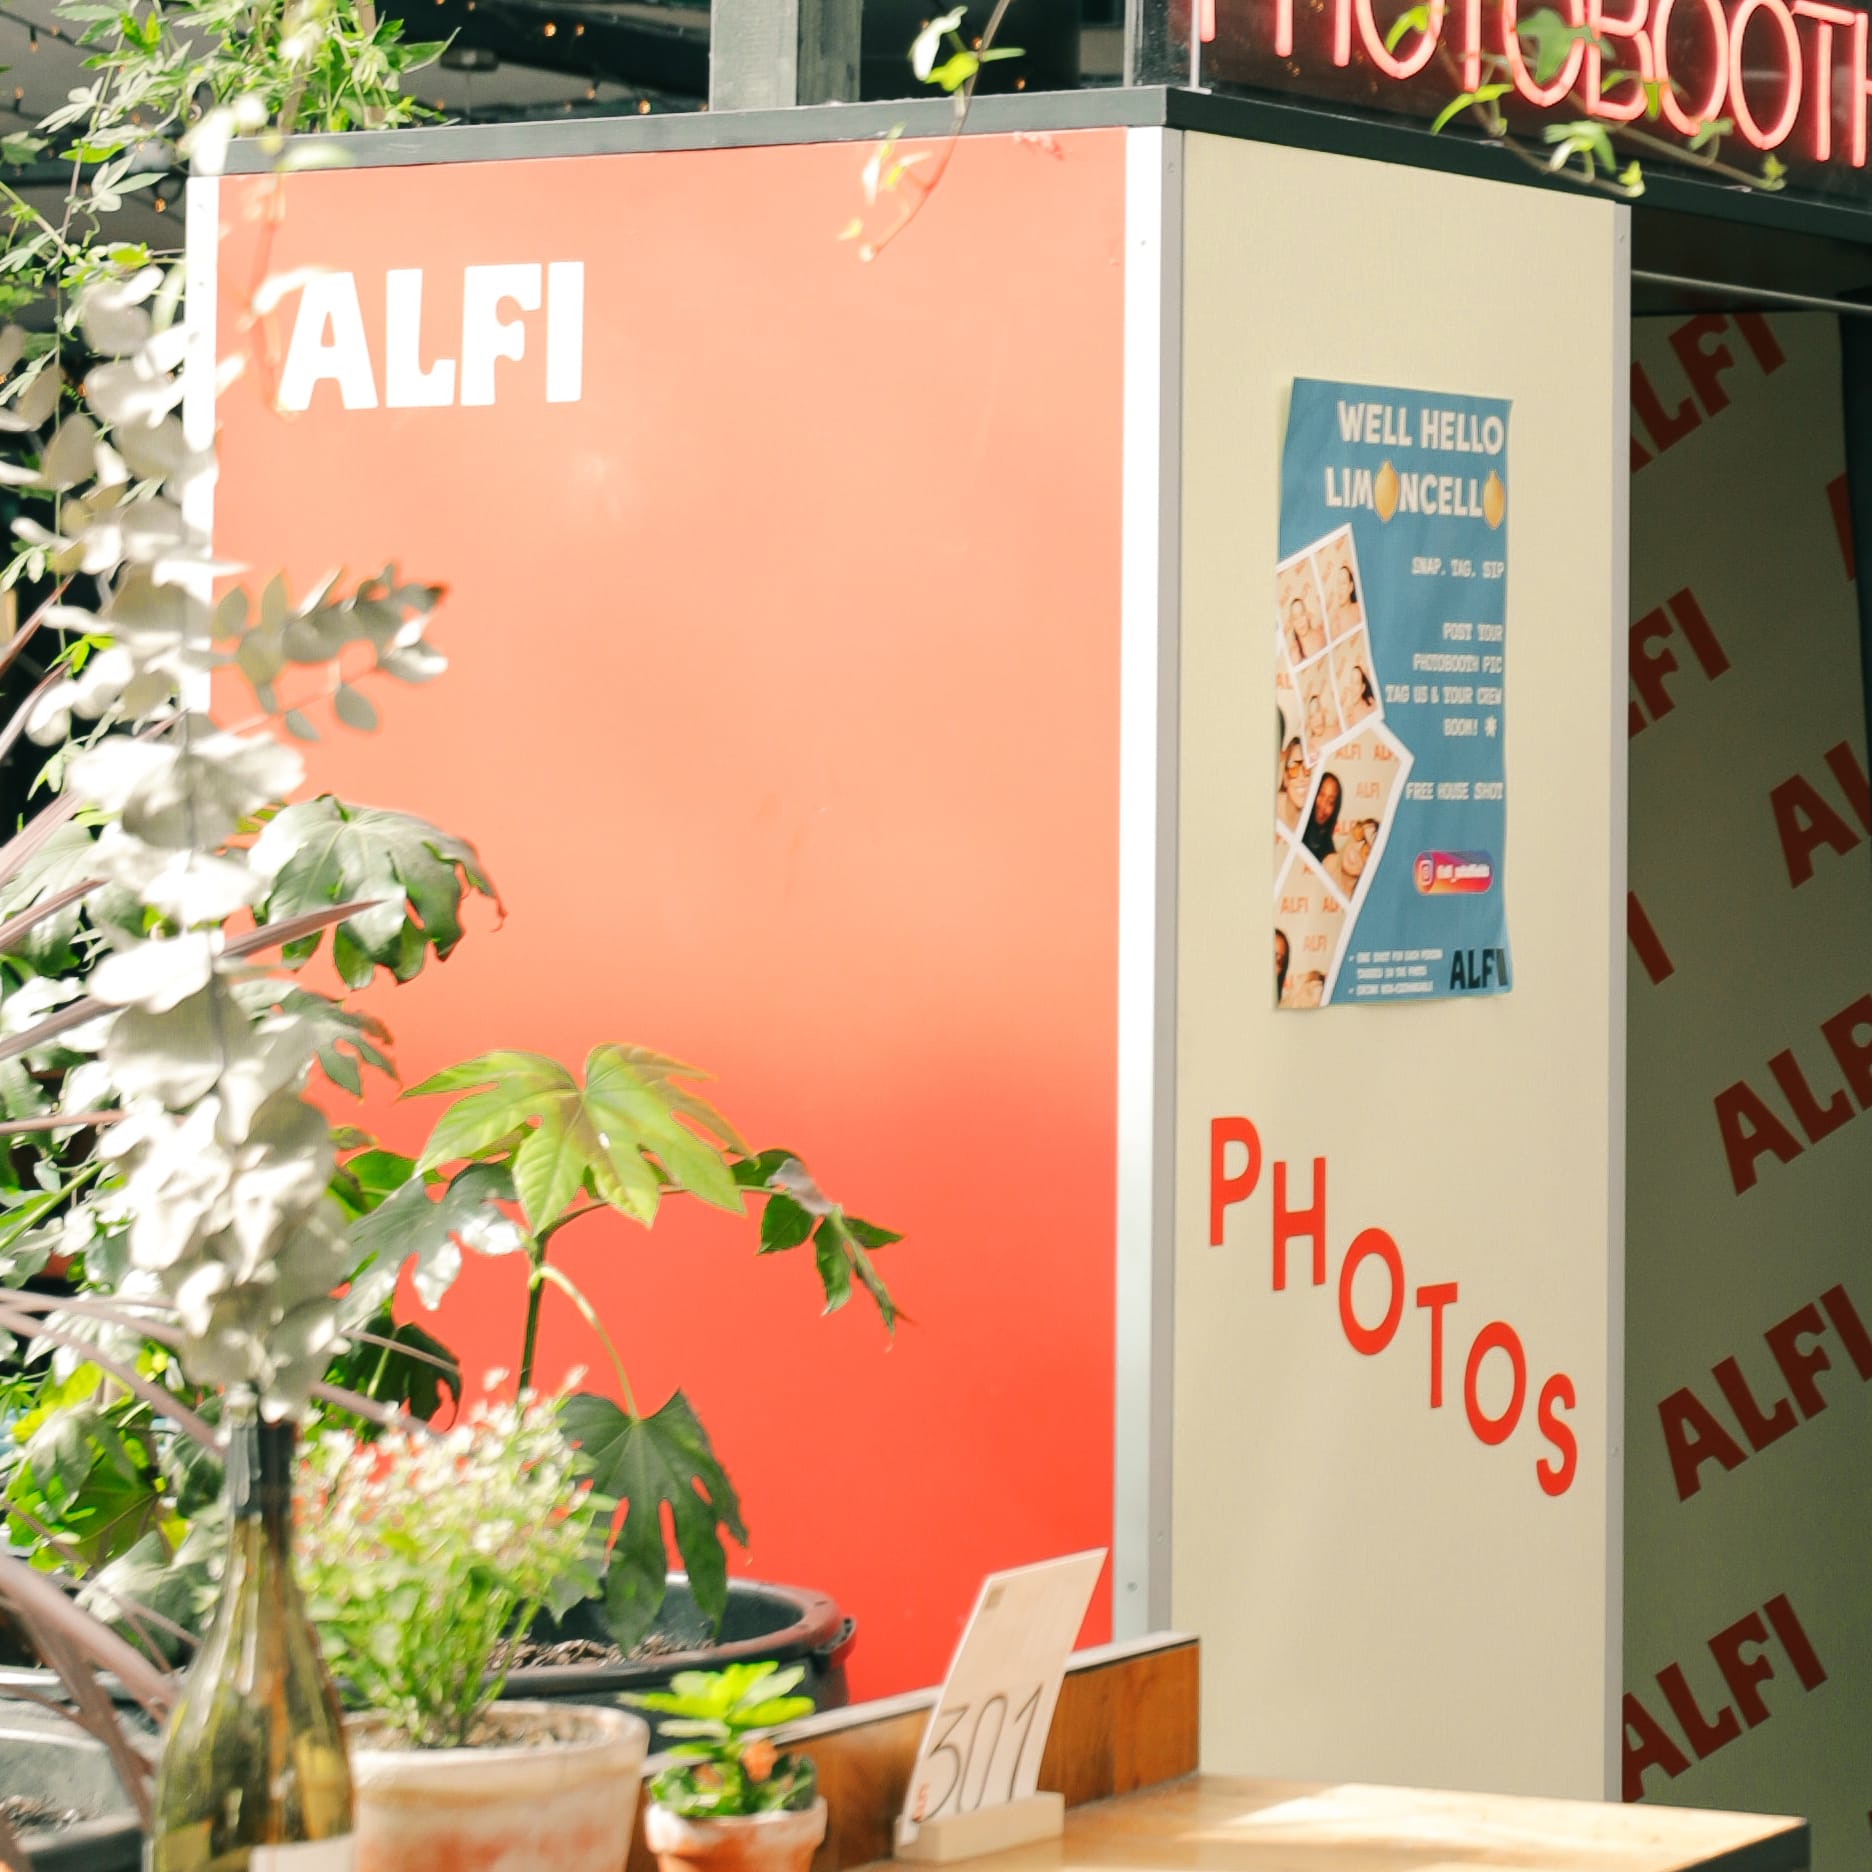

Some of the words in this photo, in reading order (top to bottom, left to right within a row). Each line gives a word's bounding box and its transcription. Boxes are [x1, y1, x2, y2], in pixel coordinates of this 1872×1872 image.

[275, 260, 585, 411] ALFI
[1630, 312, 1787, 474] LFI
[1337, 400, 1413, 447] WELL
[1420, 408, 1505, 456] HELLO
[1629, 586, 1731, 740] FI
[1449, 948, 1509, 990] ALFI
[1208, 1115, 1579, 1497] PHOTOS
[1622, 1593, 1828, 1803] ALFI
